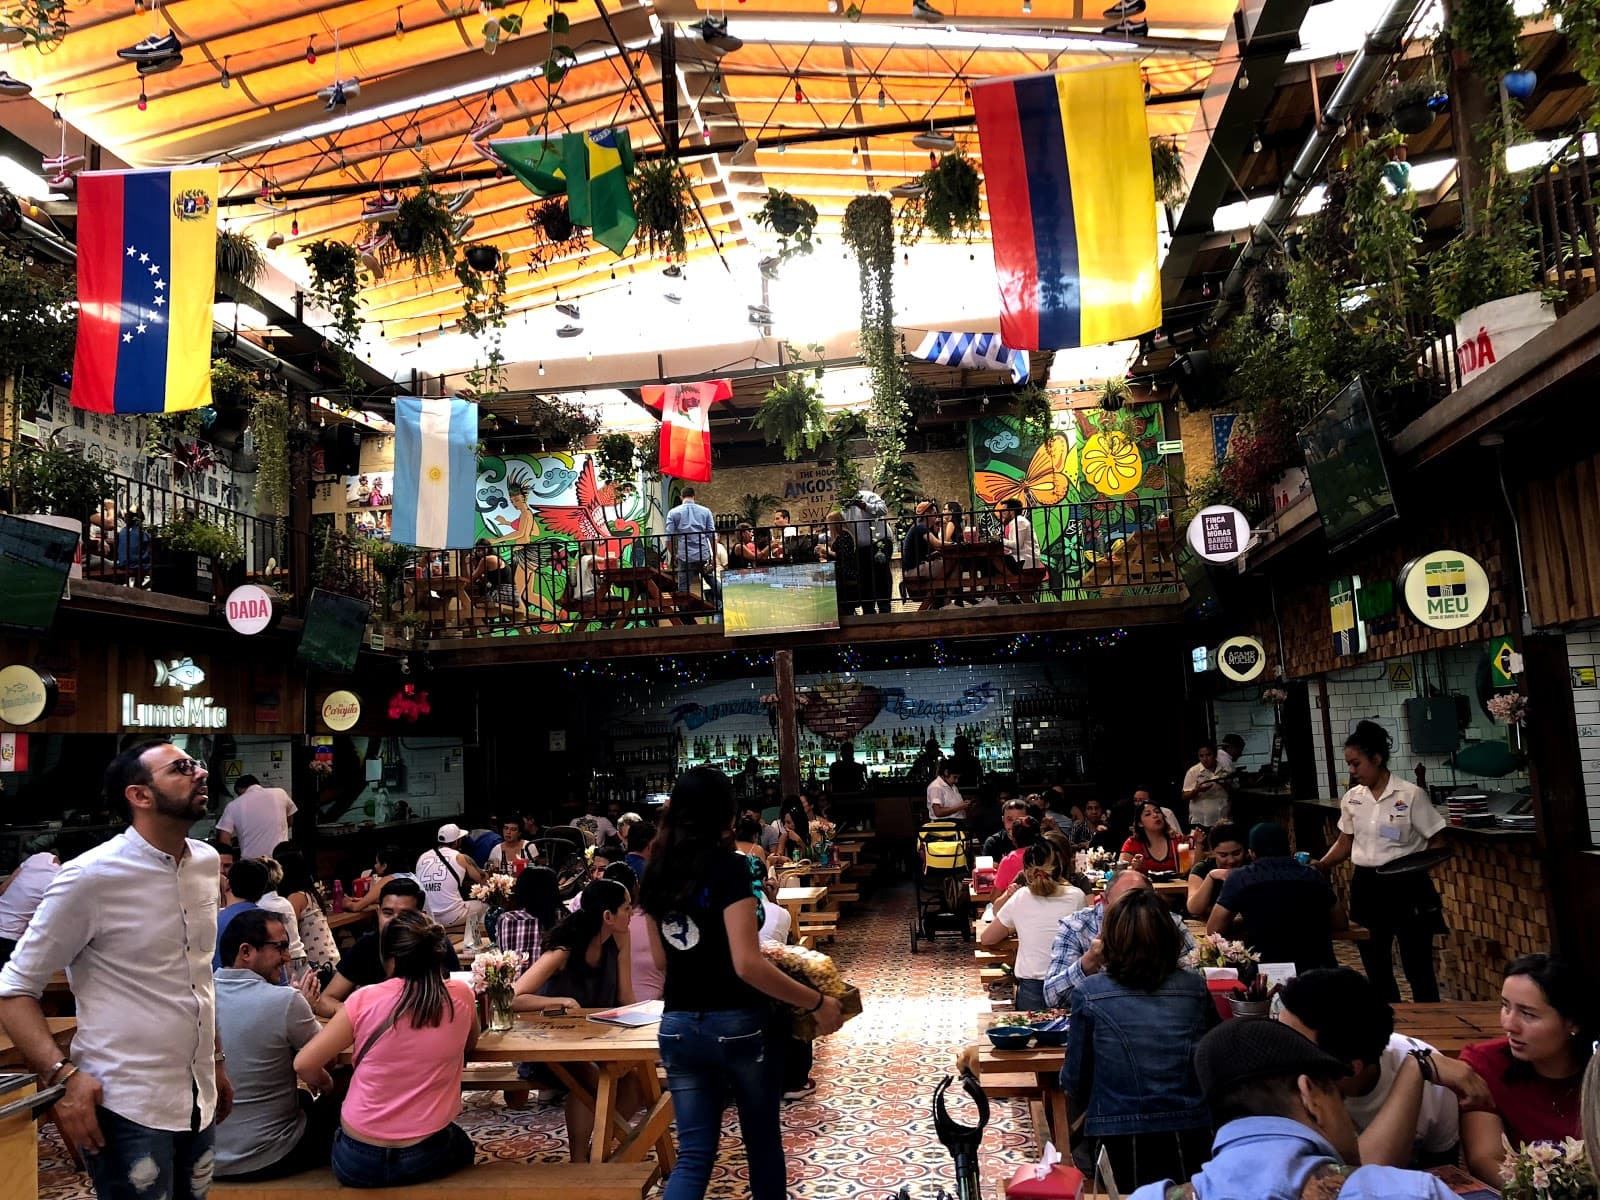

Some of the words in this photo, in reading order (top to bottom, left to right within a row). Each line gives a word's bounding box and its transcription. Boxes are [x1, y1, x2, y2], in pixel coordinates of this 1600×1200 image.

[800, 470, 813, 479] THE
[1205, 516, 1226, 524] FINCA
[1207, 529, 1232, 537] MORAS
[1208, 536, 1233, 545] BARREL
[1208, 543, 1233, 551] SELECT
[1427, 597, 1469, 614] MEU
[420, 855, 450, 882] 23
